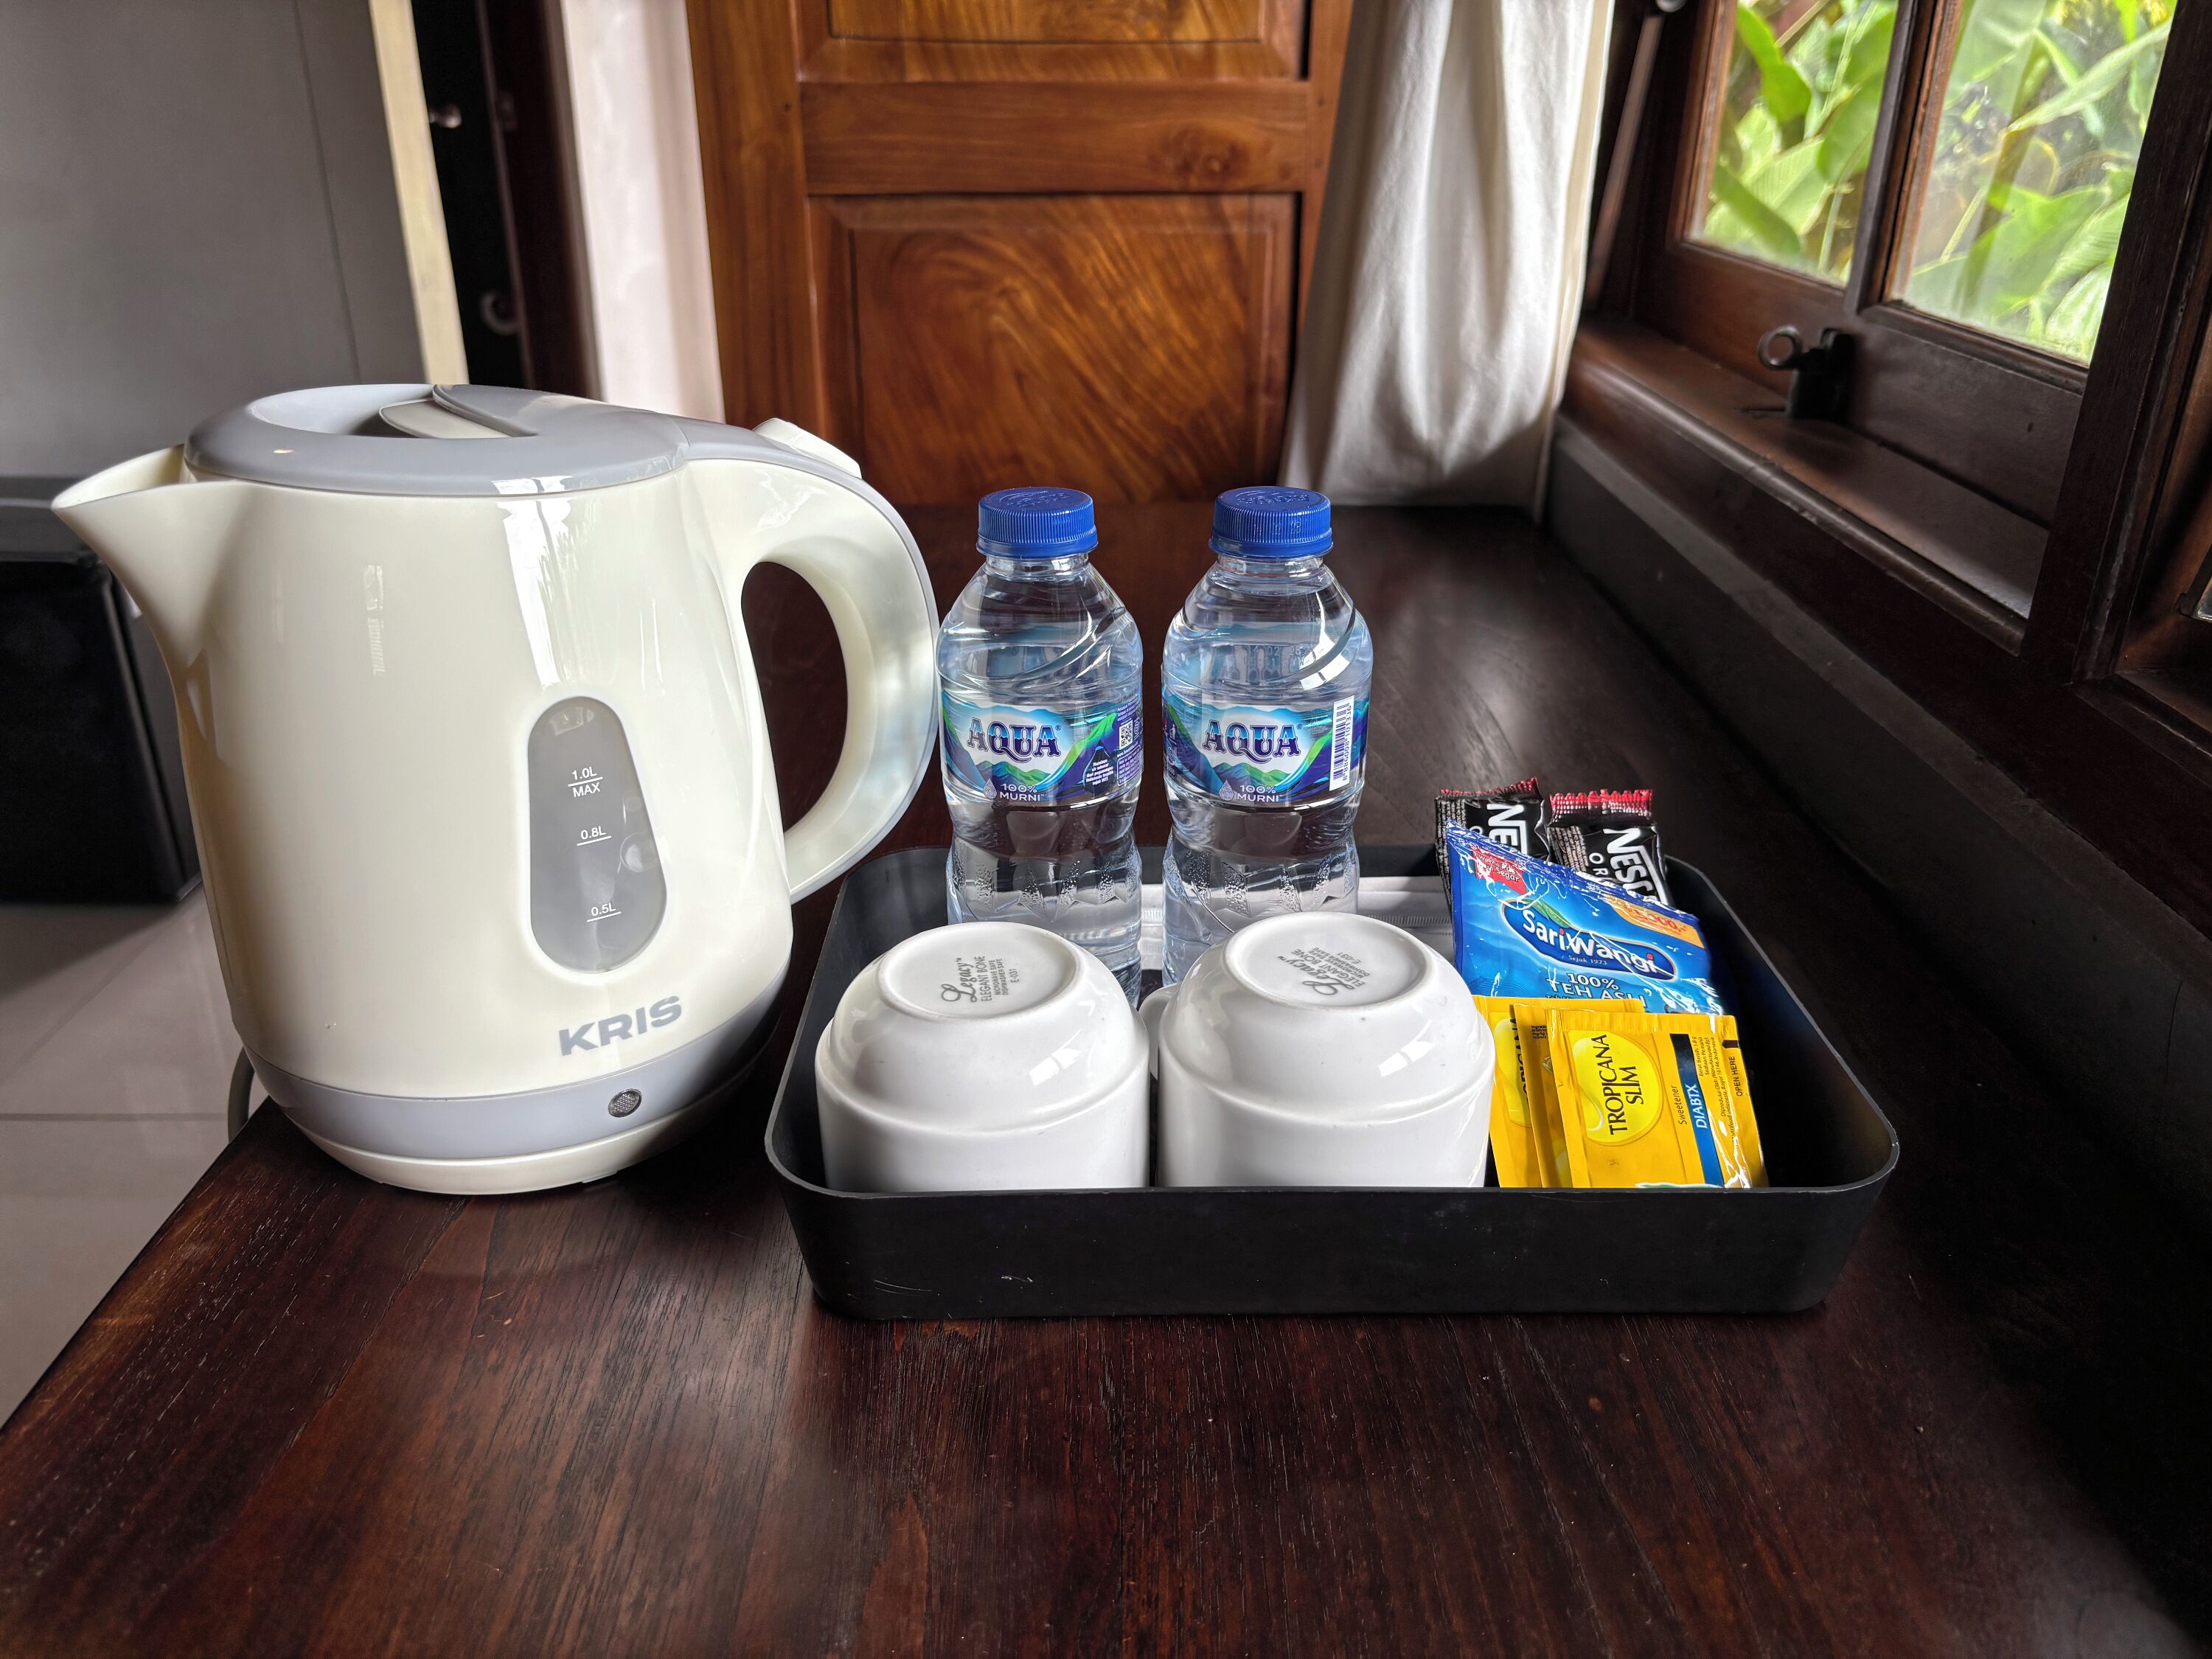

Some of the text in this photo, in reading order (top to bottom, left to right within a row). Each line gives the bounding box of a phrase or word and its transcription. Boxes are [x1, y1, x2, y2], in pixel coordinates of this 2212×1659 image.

[967, 717, 1061, 762] AQUA
[1202, 719, 1301, 764] AQUA
[572, 766, 597, 781] 1.0L
[573, 782, 600, 798] MAX
[1001, 783, 1037, 793] 100%
[1240, 785, 1276, 794] 100%
[1000, 791, 1041, 801] MURNI
[1236, 793, 1280, 802] MURNI
[580, 826, 606, 841] 0.8L
[591, 902, 616, 917] 0.5L
[975, 956, 992, 1001] ELEGANT BONE
[1290, 948, 1366, 987] ELEGANT BONE
[1566, 973, 1619, 991] 100%
[558, 995, 683, 1056] KRIS
[1591, 1034, 1628, 1135] TROPICANA
[1619, 1065, 1644, 1105] SLIM
[1728, 1056, 1743, 1096] OPEN HERE
[1672, 1085, 1687, 1125] Sweetener
[1686, 1084, 1708, 1128] DIABTX
